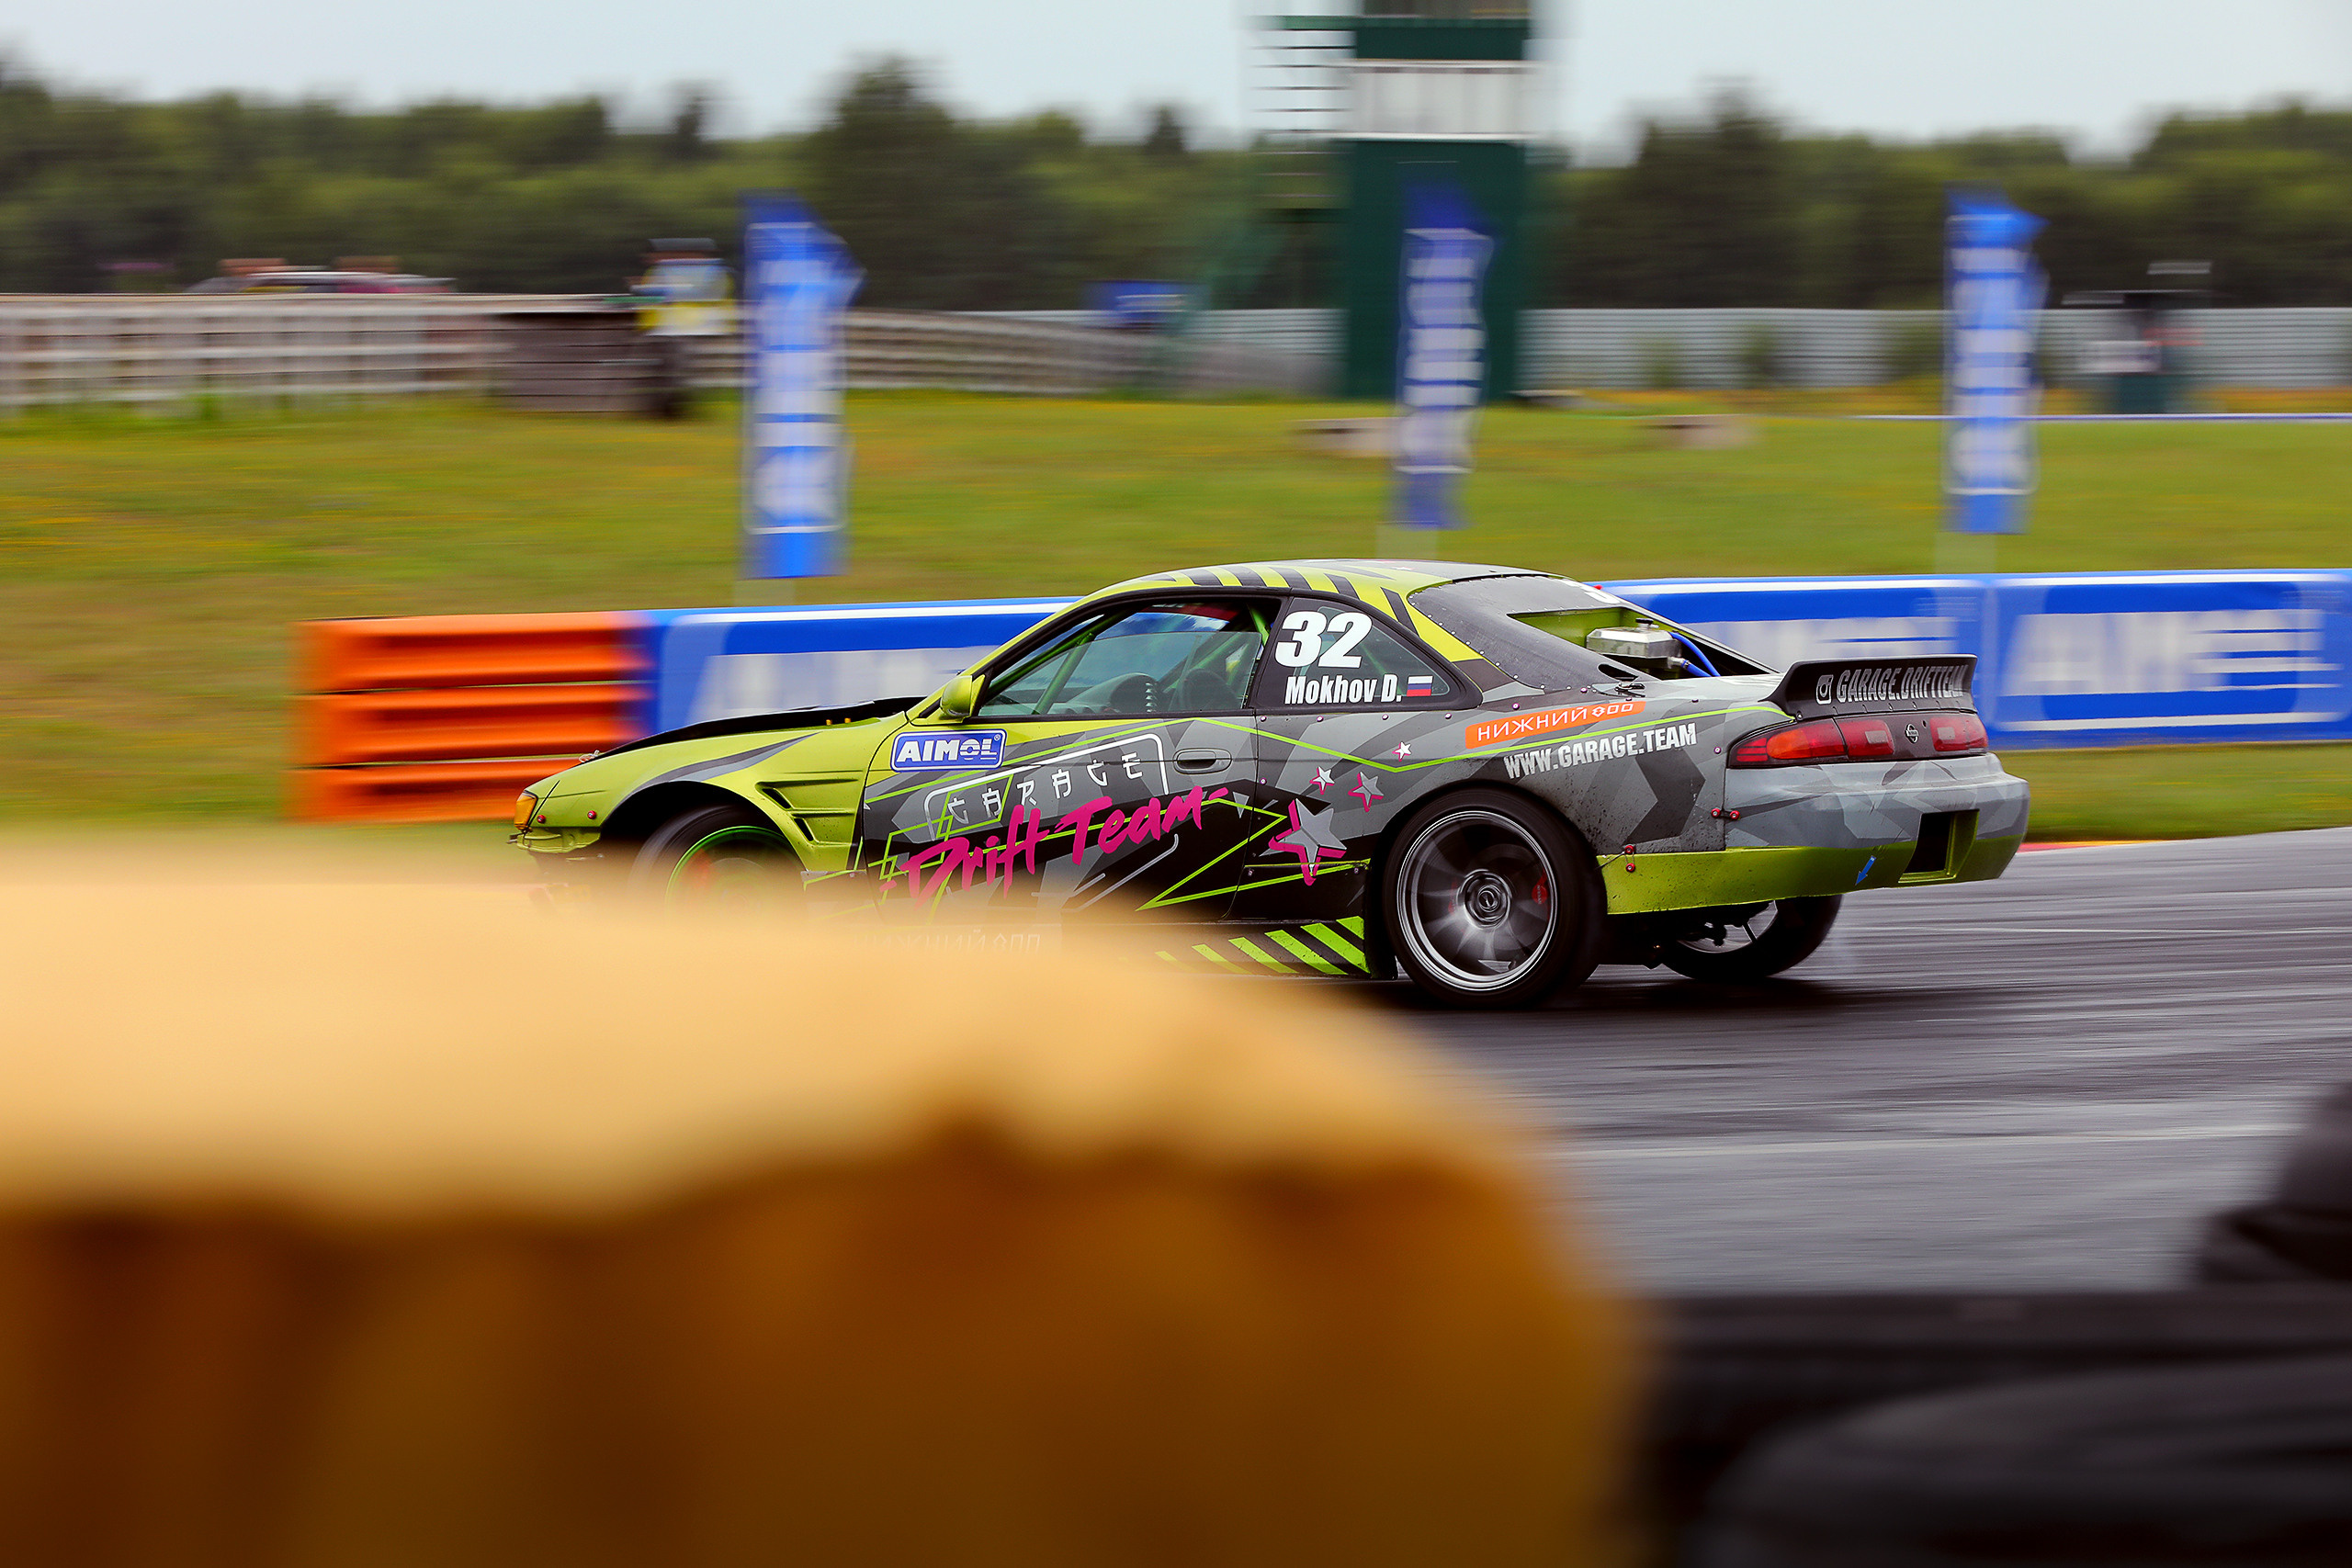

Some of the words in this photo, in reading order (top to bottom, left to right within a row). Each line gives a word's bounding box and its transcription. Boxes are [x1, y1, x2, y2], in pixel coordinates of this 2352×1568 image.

[1274, 611, 1373, 668] 32
[1284, 674, 1377, 705] Mokhov
[1381, 673, 1402, 703] D.
[1503, 722, 1698, 779] WWW.GARAGE.TEAM
